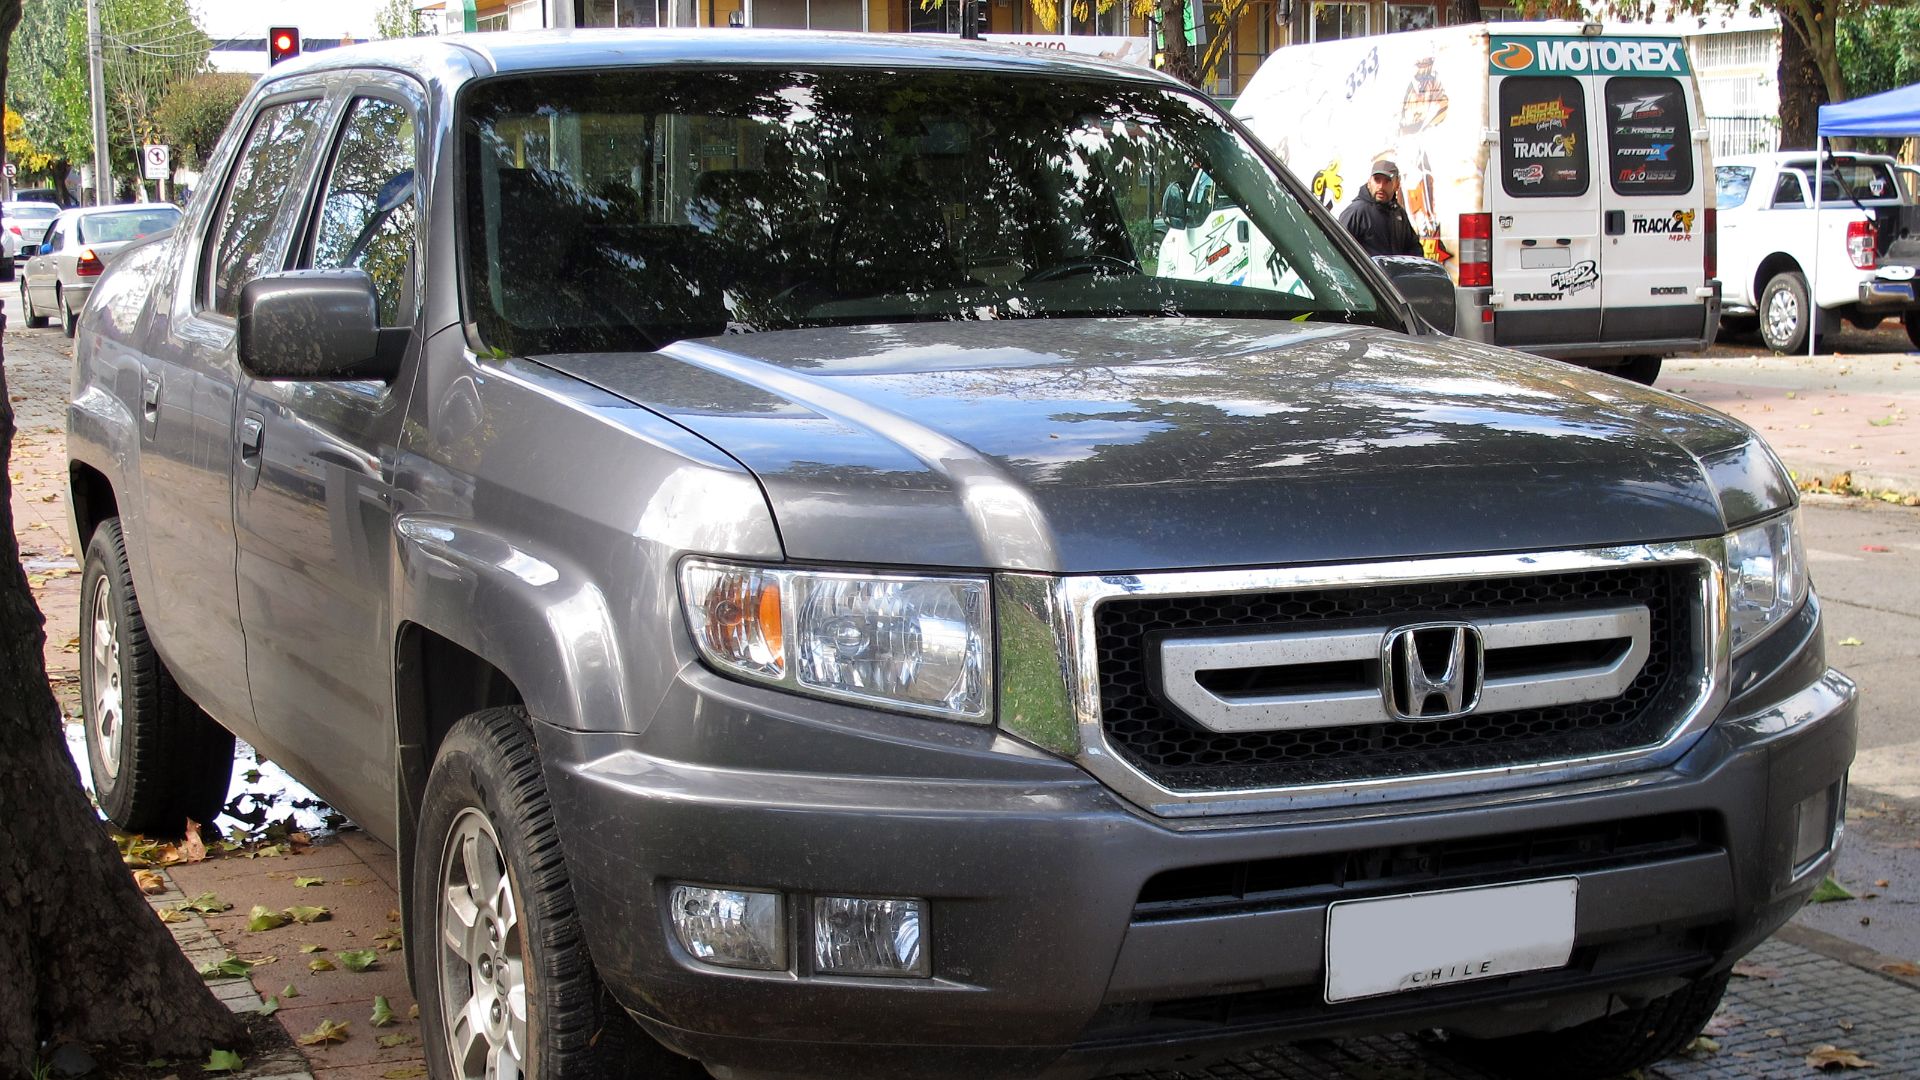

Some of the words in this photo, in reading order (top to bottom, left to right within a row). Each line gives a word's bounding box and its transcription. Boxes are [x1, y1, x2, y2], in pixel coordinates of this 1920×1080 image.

[1536, 41, 1681, 71] MOTOREX
[1514, 293, 1563, 301] PEUGEOT
[1412, 961, 1491, 982] CHILE
